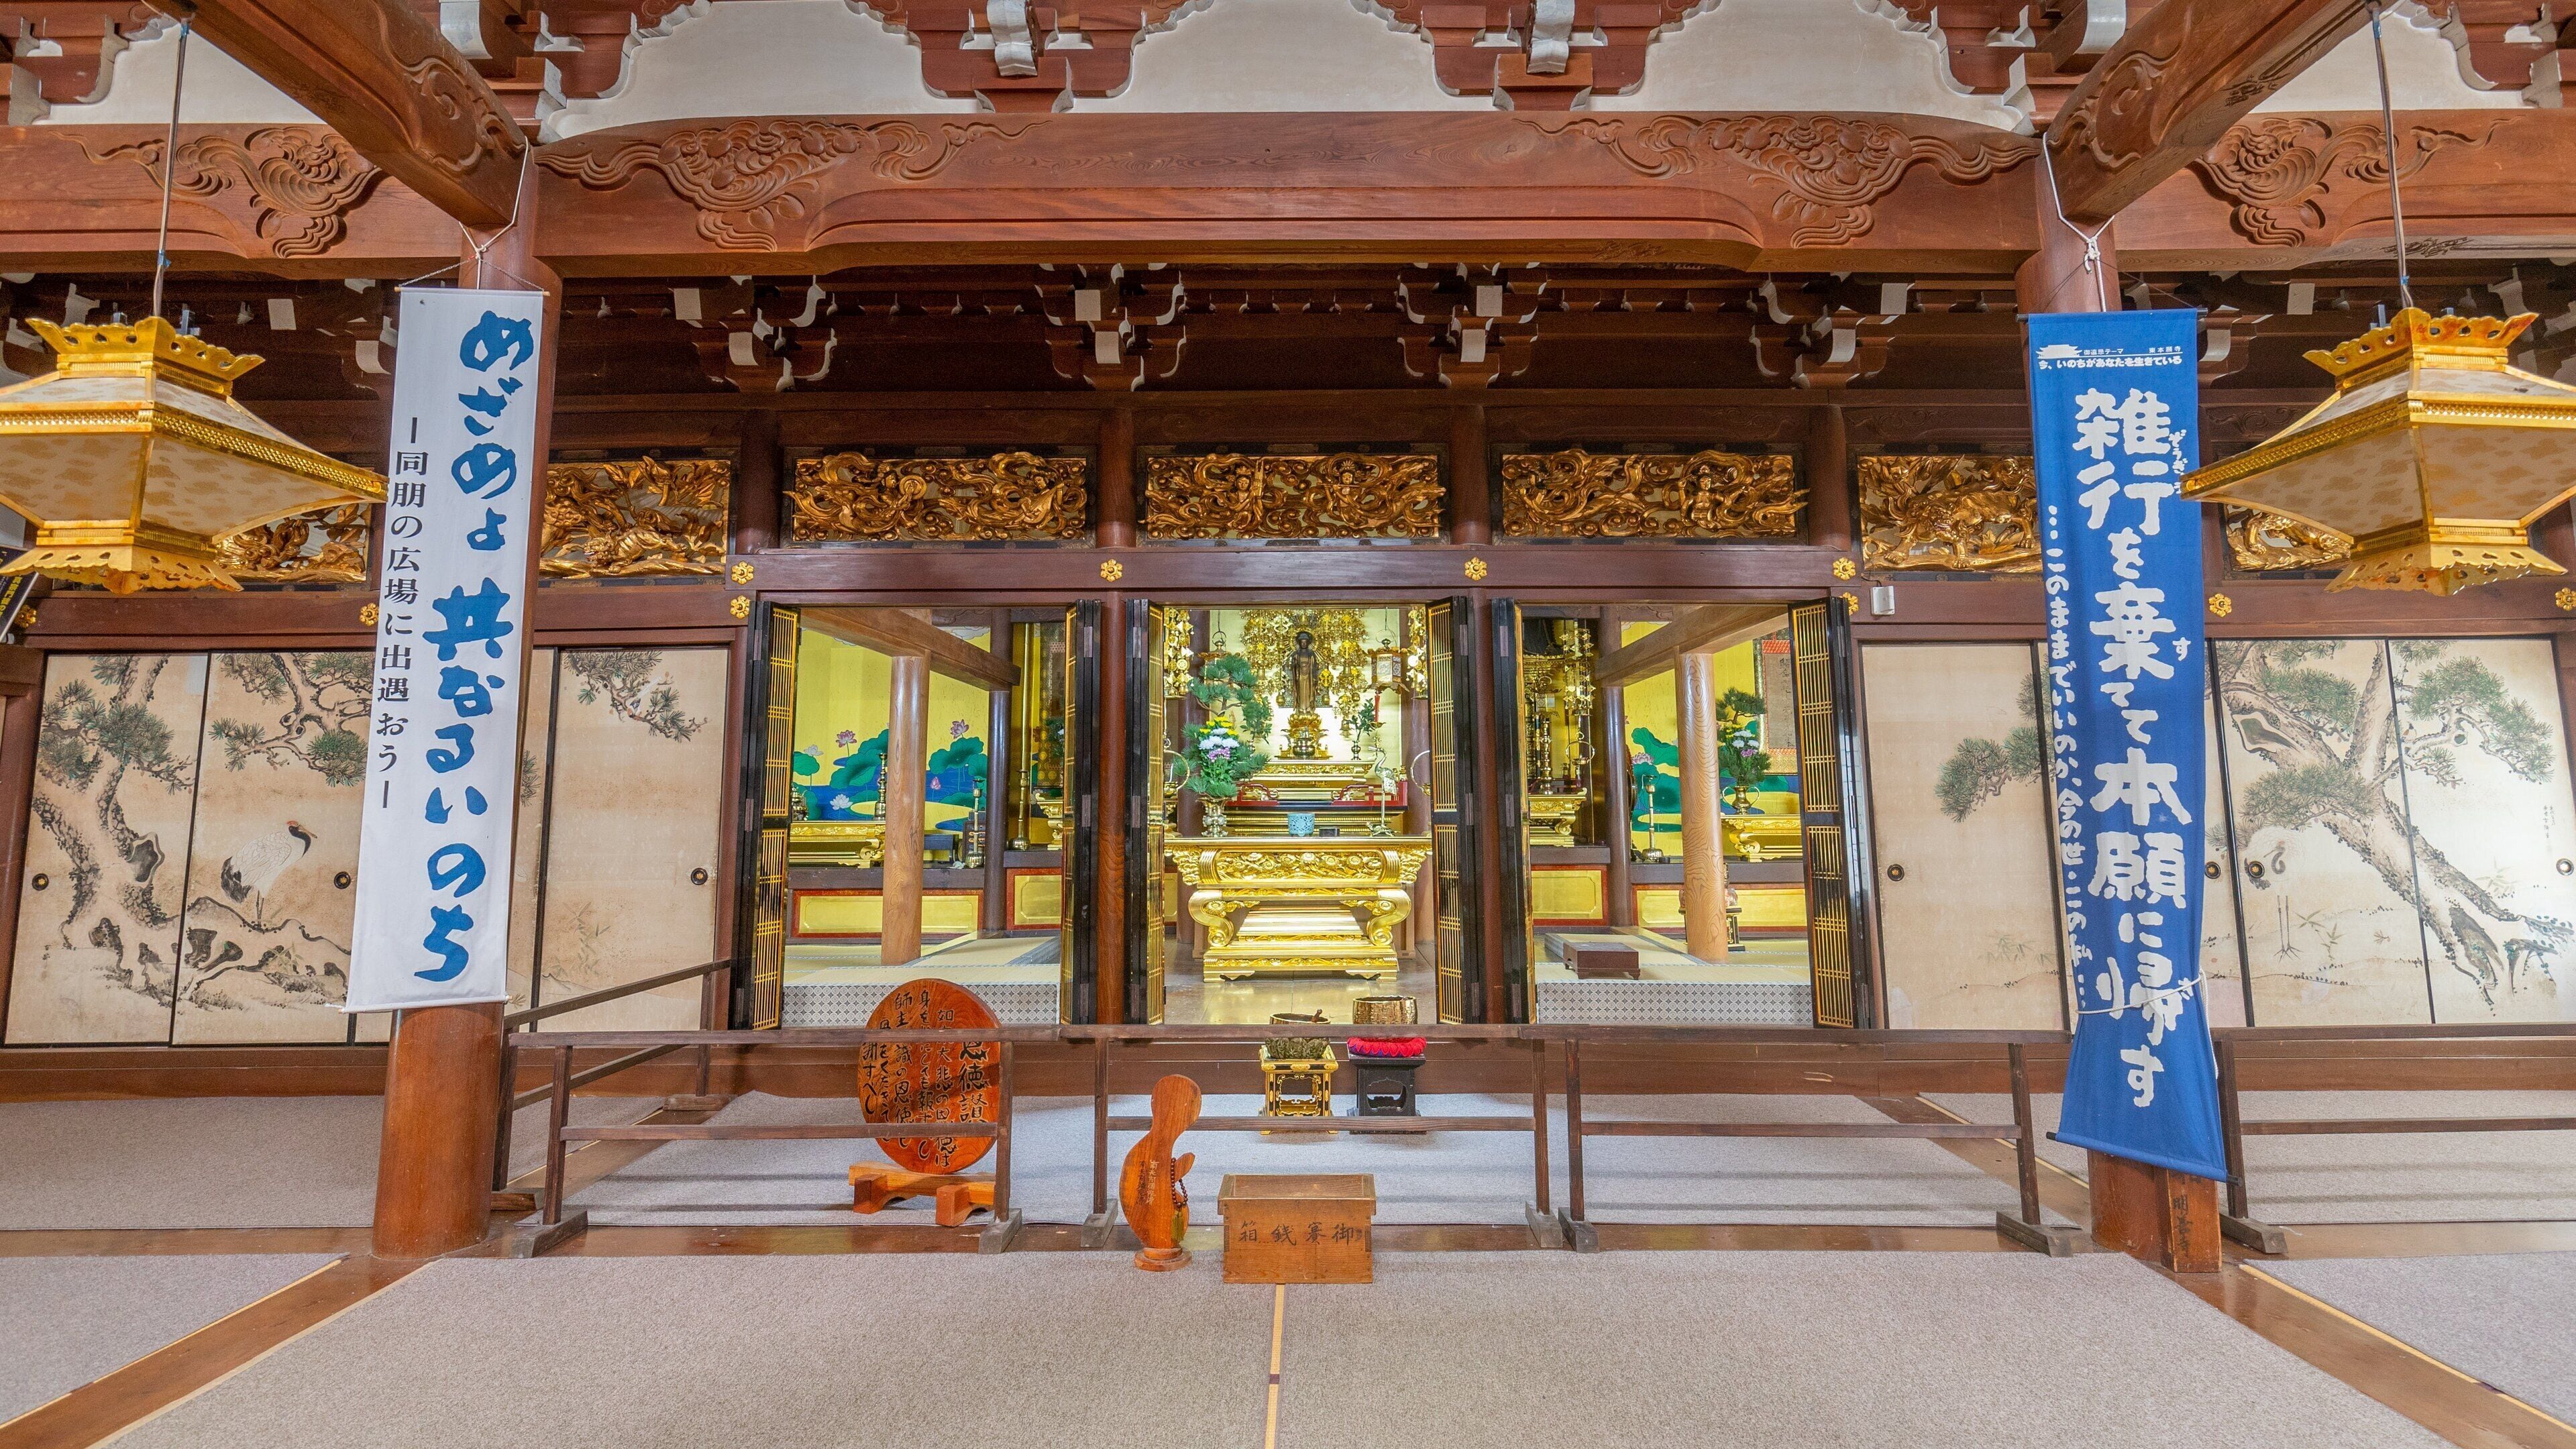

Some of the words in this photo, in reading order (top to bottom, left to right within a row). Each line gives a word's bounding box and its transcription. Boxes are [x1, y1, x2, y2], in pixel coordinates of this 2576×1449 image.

[2038, 356, 2183, 370] 今、いのちがあなたを生きている
